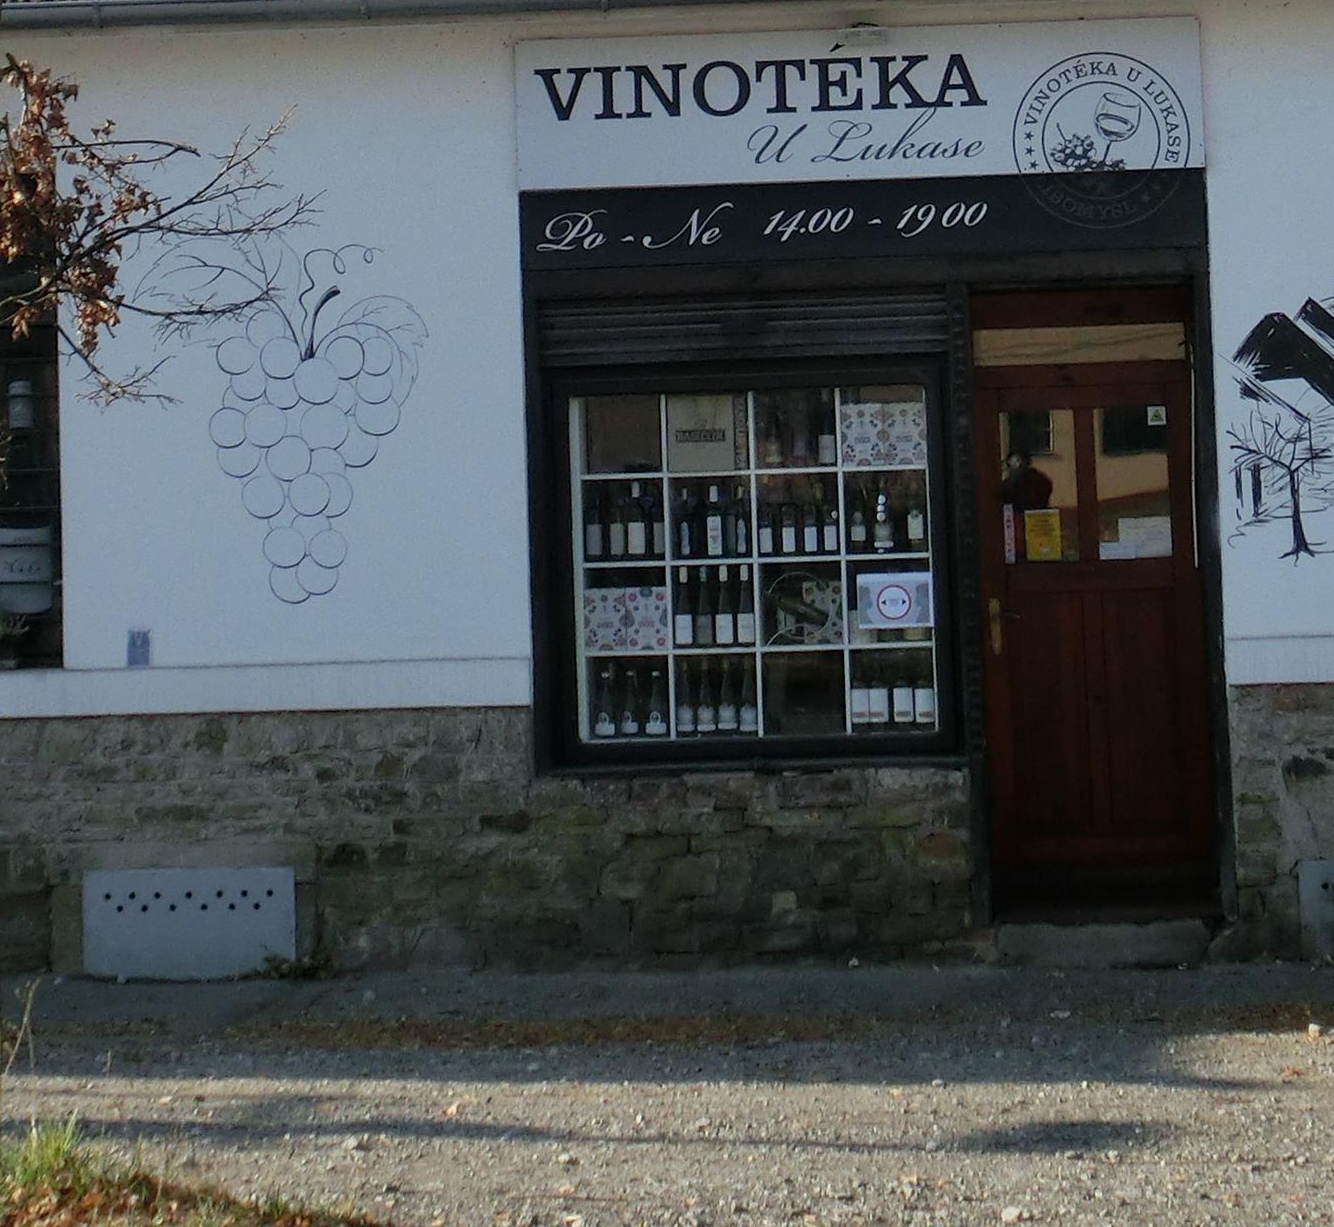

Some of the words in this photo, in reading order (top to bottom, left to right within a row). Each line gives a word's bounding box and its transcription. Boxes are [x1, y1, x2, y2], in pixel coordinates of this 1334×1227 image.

[534, 42, 988, 122] VINOTÉKA
[1023, 59, 1119, 127] VINOTÉKA
[1126, 66, 1143, 83] U
[1142, 79, 1182, 164] LUKASE
[747, 124, 808, 165] U
[811, 106, 985, 163] Lukase
[535, 208, 609, 253] Po
[642, 202, 734, 249] Ne
[763, 206, 855, 239] 14.00
